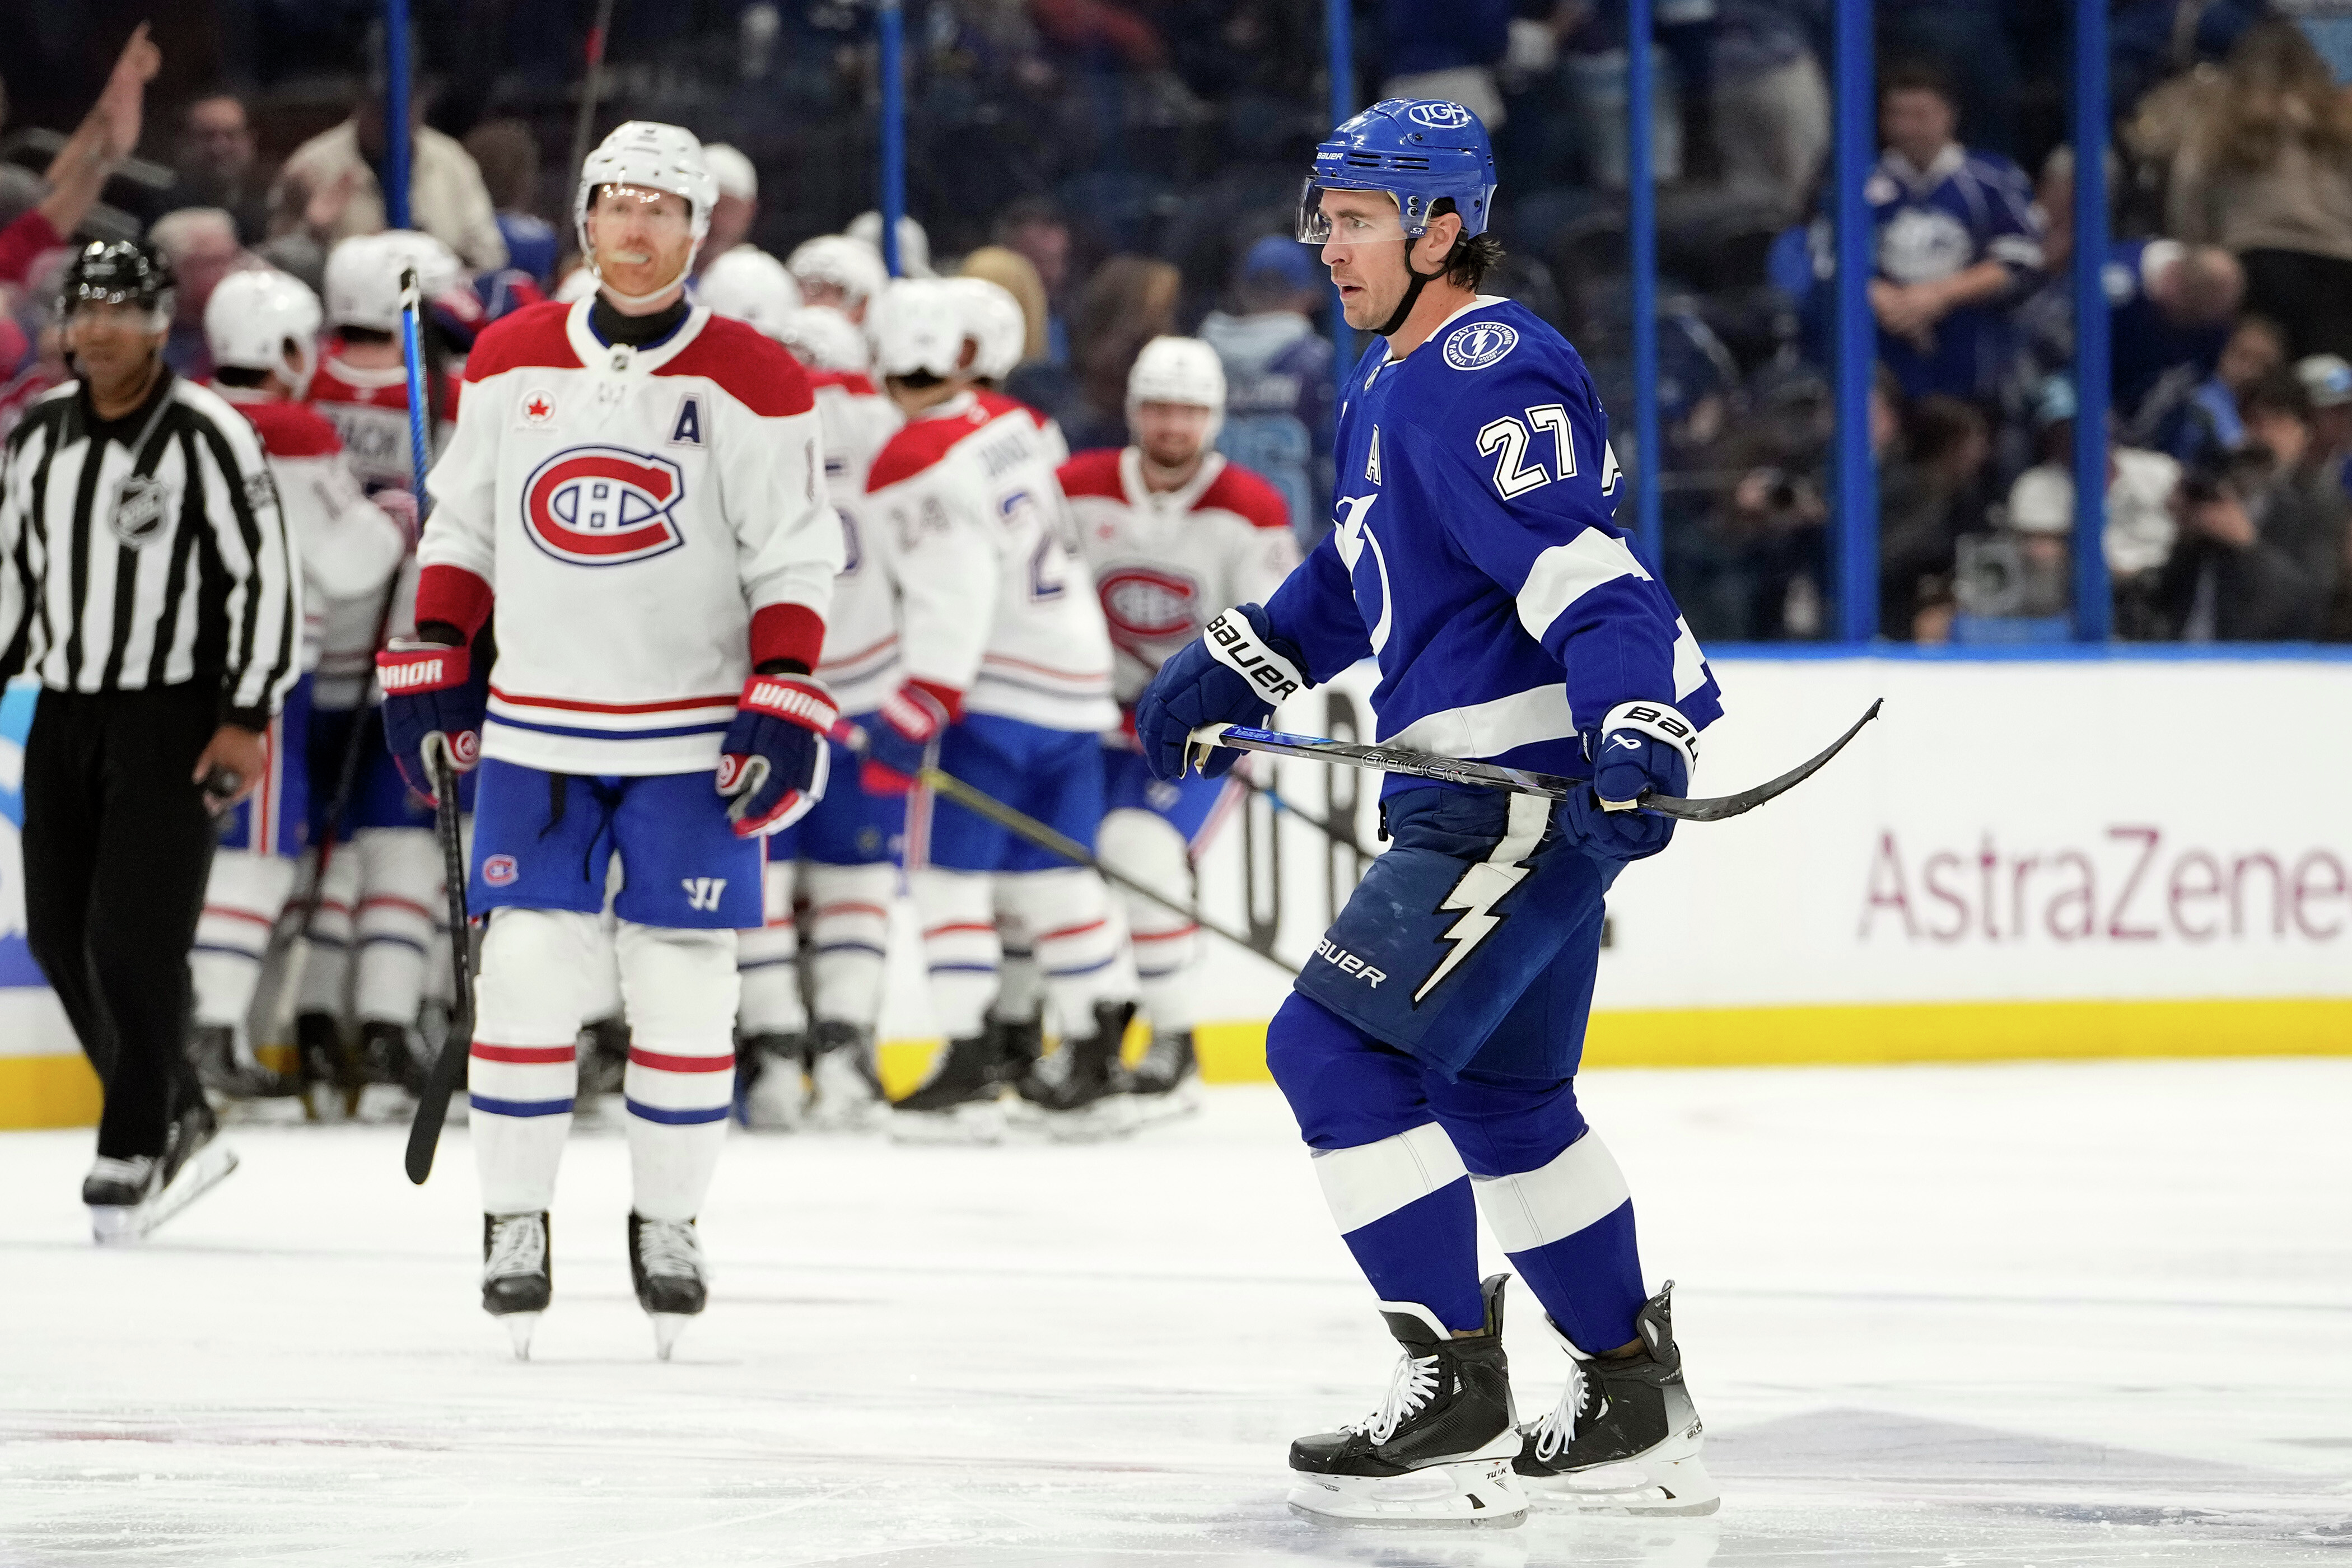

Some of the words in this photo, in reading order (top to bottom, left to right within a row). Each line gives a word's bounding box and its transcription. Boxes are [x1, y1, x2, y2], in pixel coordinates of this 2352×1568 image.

[1413, 103, 1468, 121] TGH
[1453, 328, 1469, 342] BAY
[1473, 324, 1513, 345] LIGHTNING
[1449, 343, 1467, 366] TAMPA
[669, 395, 707, 449] A
[1365, 424, 1382, 487] A
[1476, 404, 1578, 501] 27
[1622, 706, 1698, 775] BAU
